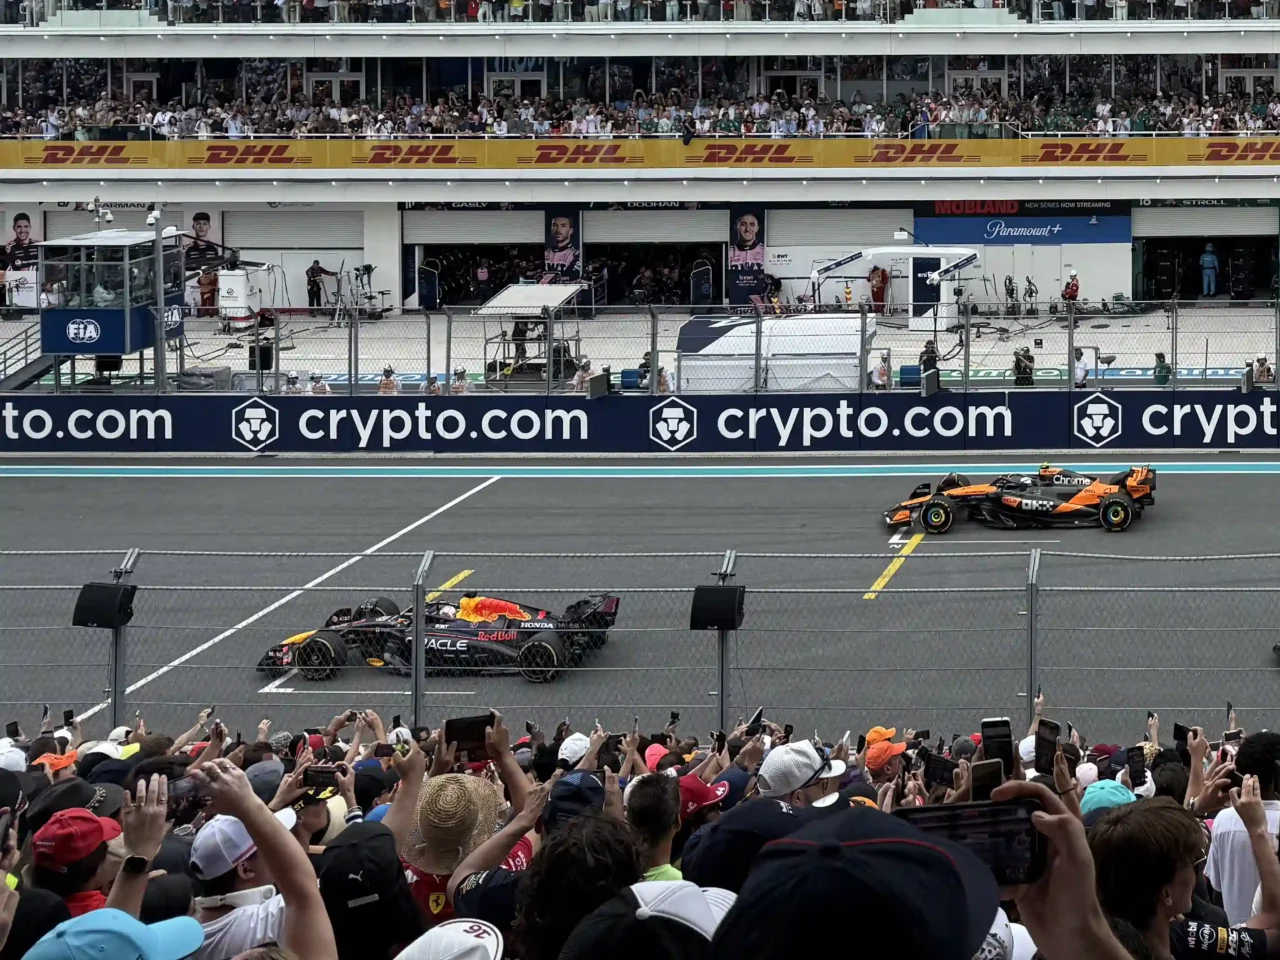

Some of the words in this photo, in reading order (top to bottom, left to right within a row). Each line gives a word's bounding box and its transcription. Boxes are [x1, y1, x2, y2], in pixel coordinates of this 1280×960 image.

[42, 145, 131, 164] DHL
[205, 144, 295, 164] DHL
[368, 144, 459, 164] DHL
[534, 144, 627, 164] DHL
[703, 143, 796, 164] DHL
[871, 143, 963, 163] DHL
[1039, 142, 1130, 162] DHL
[935, 200, 1020, 214] MOBLAND
[983, 219, 1063, 240] Paramount+
[2, 402, 173, 440] to.com
[298, 401, 589, 449] crypto.com
[717, 399, 1013, 447] crypto.com
[1021, 499, 1054, 511] OKX
[477, 631, 498, 642] Red
[499, 630, 517, 640] Bull
[462, 924, 492, 940] 16
